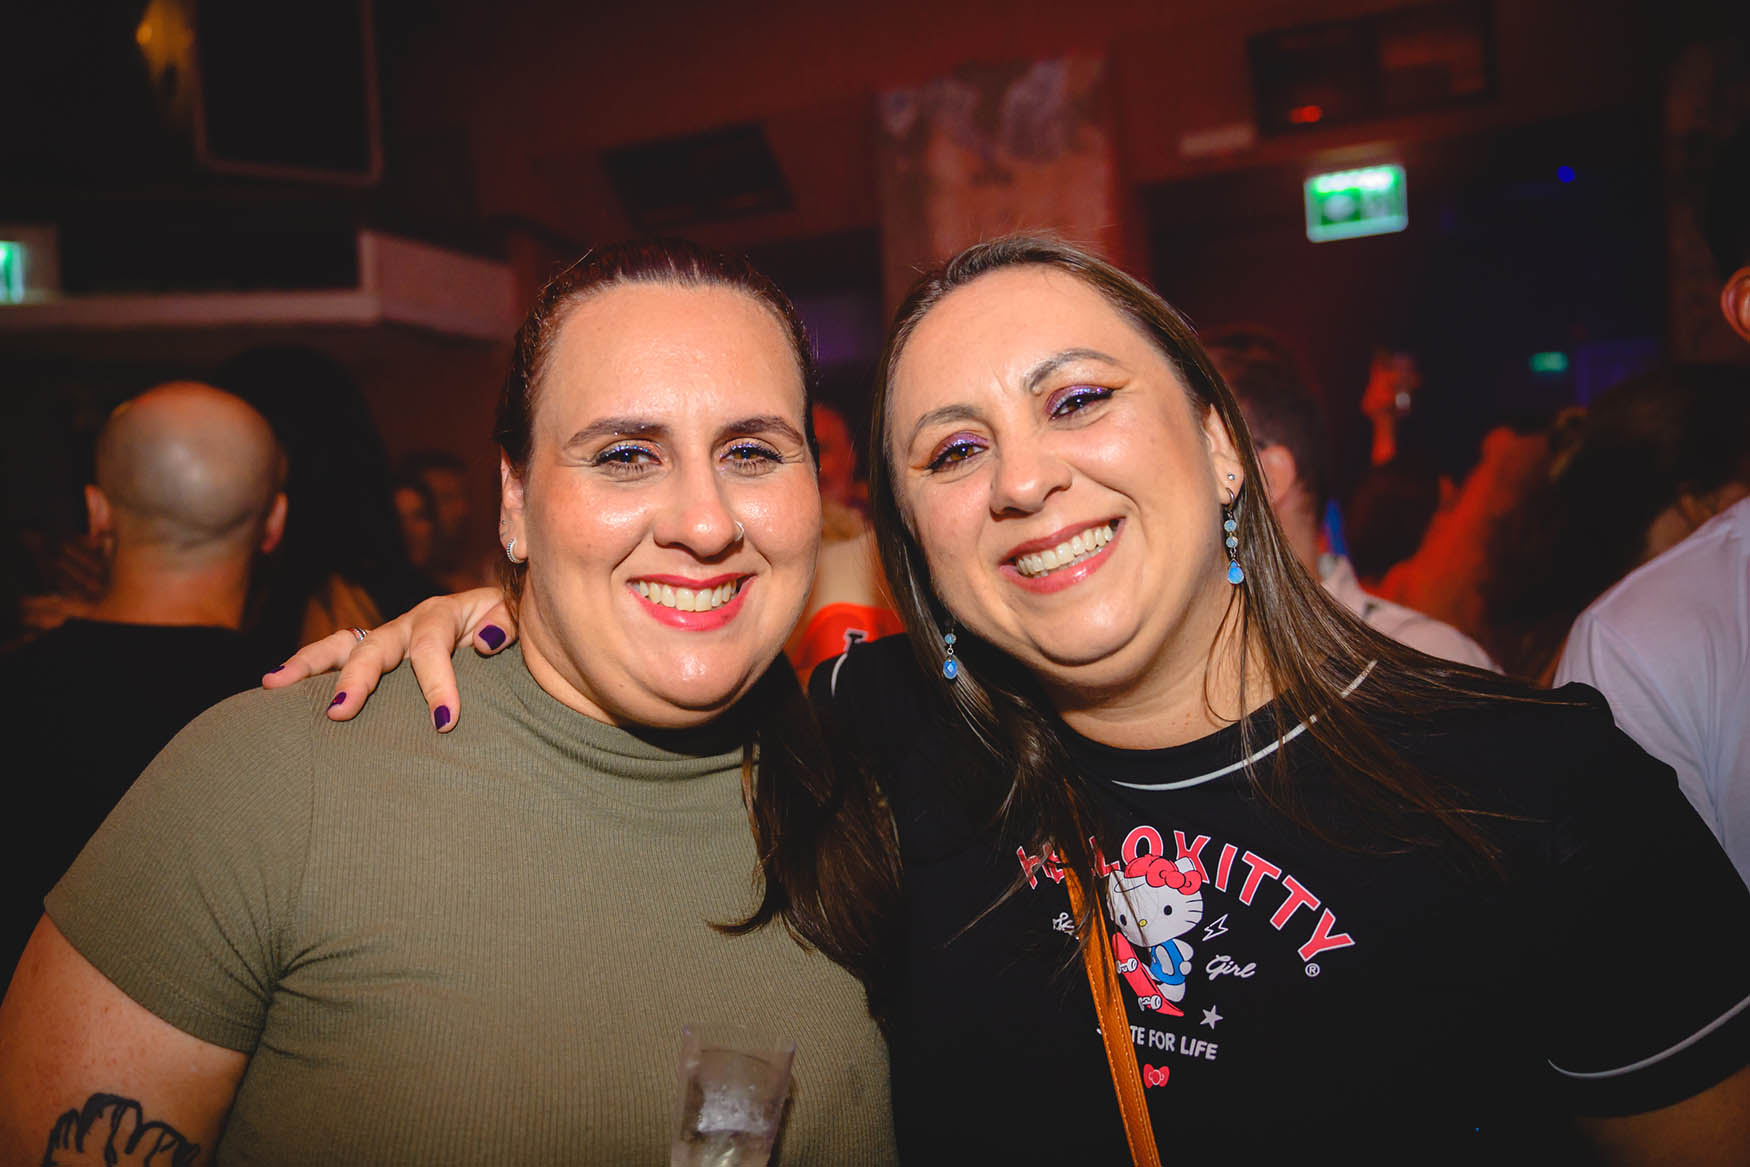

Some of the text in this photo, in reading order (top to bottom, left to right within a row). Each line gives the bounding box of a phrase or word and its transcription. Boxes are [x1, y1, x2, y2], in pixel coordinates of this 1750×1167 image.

[1205, 954, 1257, 980] Girl
[1148, 1029, 1176, 1052] FOR
[1180, 1036, 1218, 1060] LIFE
